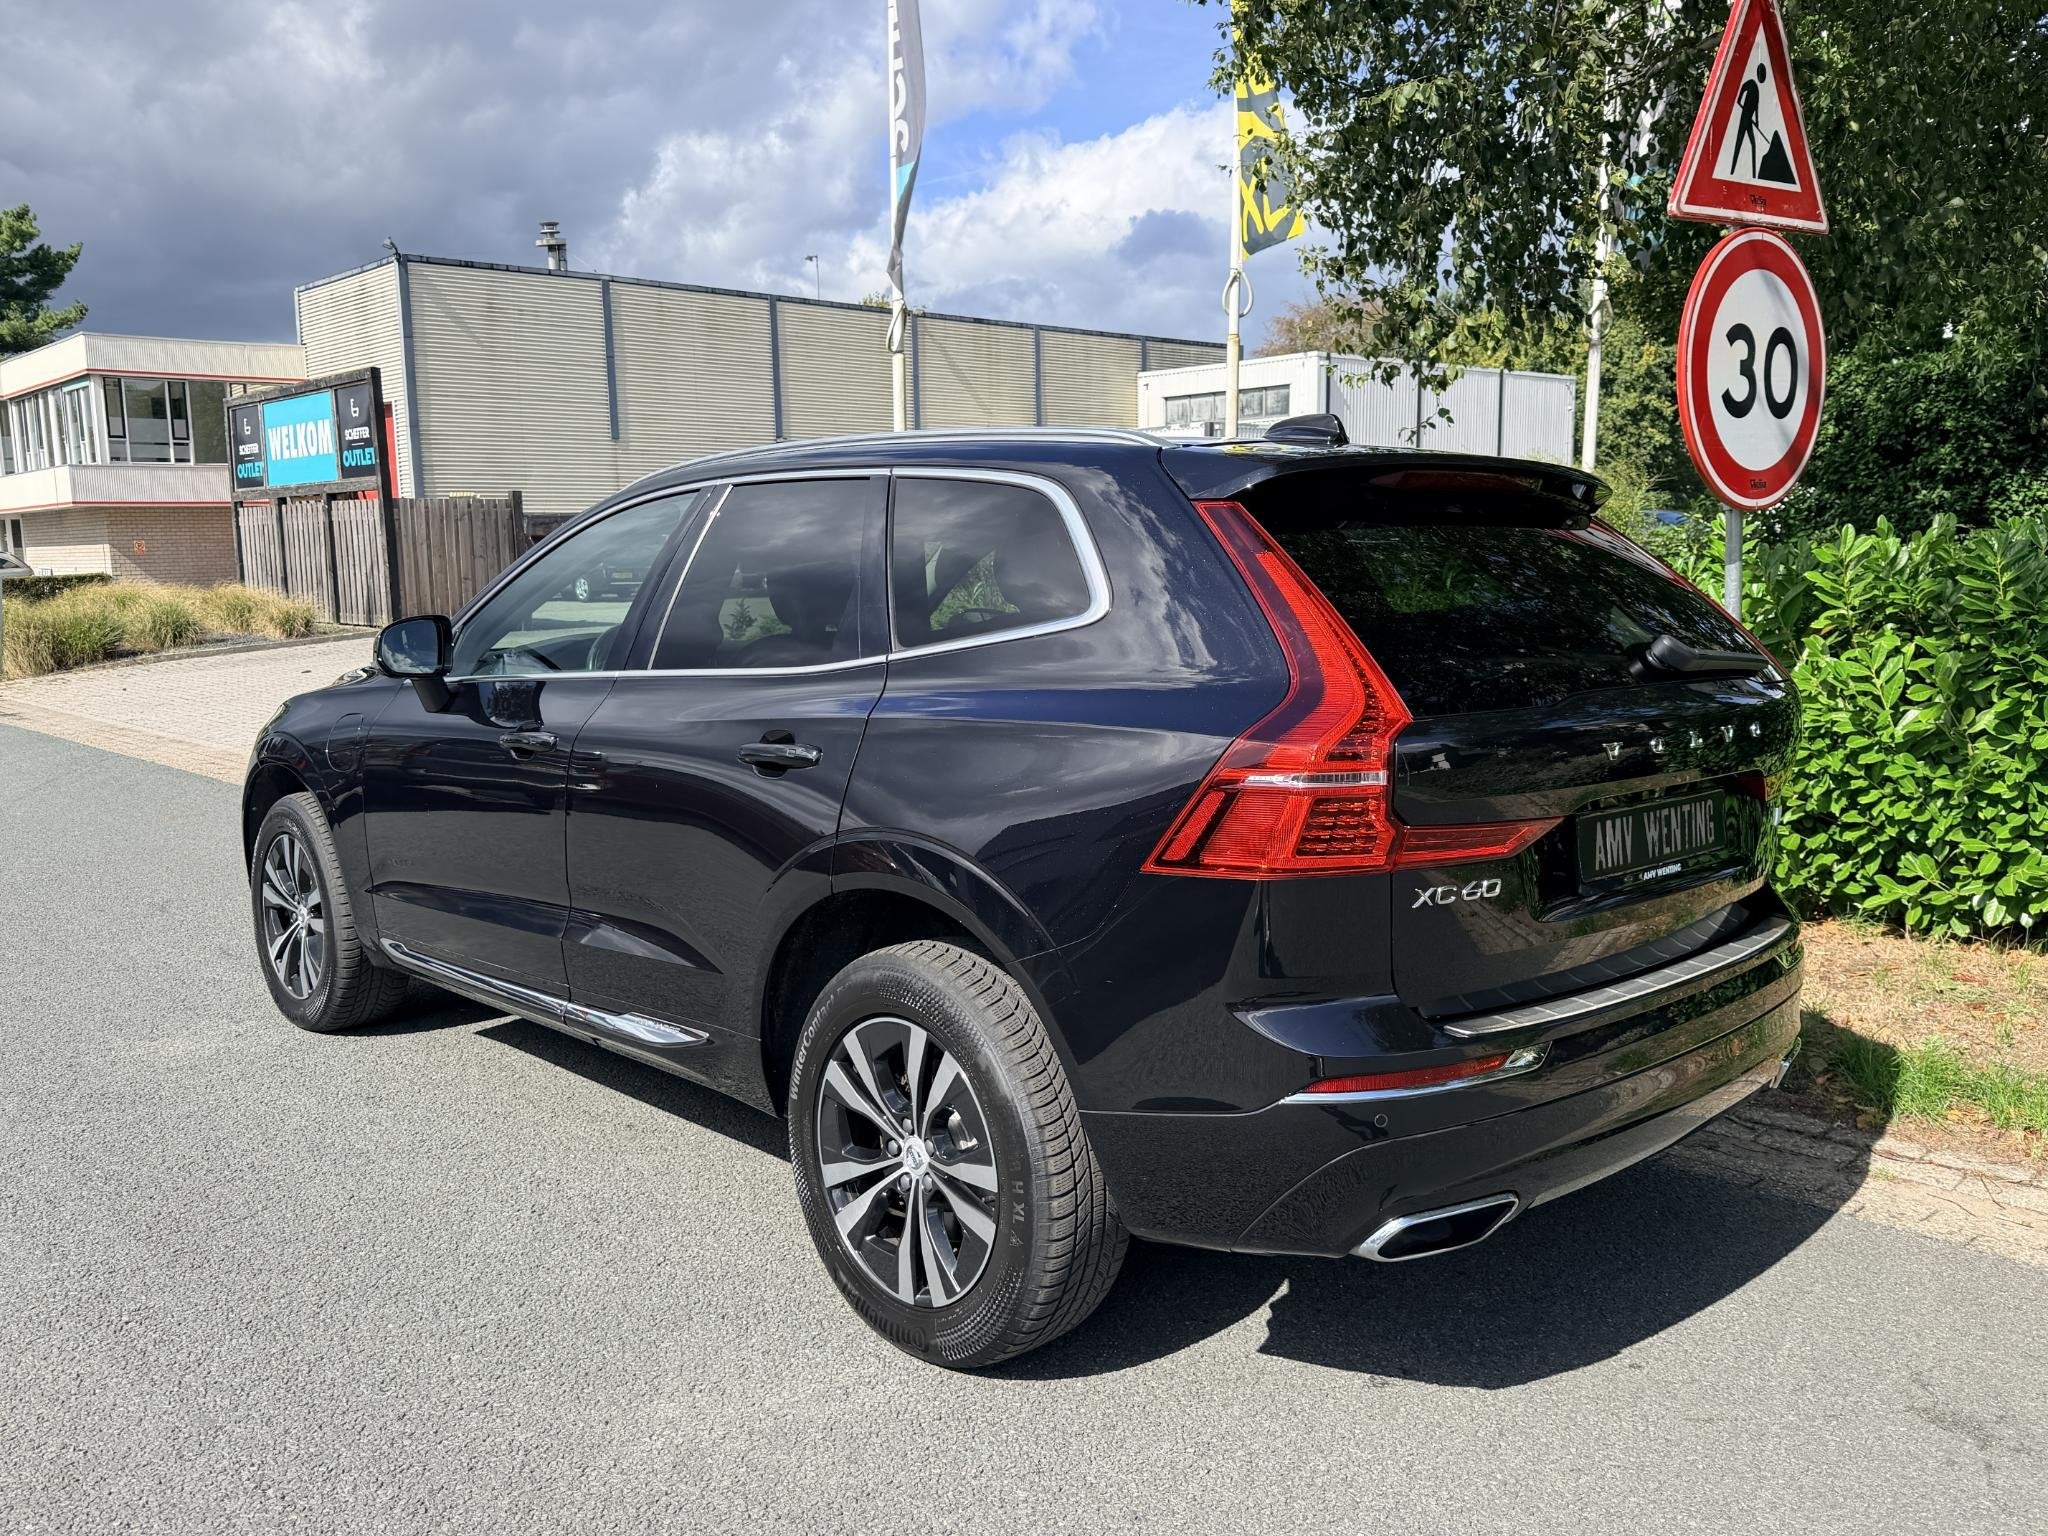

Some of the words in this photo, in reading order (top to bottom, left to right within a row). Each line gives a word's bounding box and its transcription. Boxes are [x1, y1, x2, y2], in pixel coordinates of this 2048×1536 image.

[1721, 322, 1799, 420] 30
[267, 418, 334, 460] WELKOM
[237, 461, 264, 478] OUTLET
[342, 447, 375, 467] OUTLET
[1602, 721, 1761, 761] VOLVO
[1643, 799, 1715, 859] WENTING
[1657, 863, 1682, 877] WENTING
[1411, 878, 1502, 909] XC60
[1012, 1201, 1025, 1224] XL
